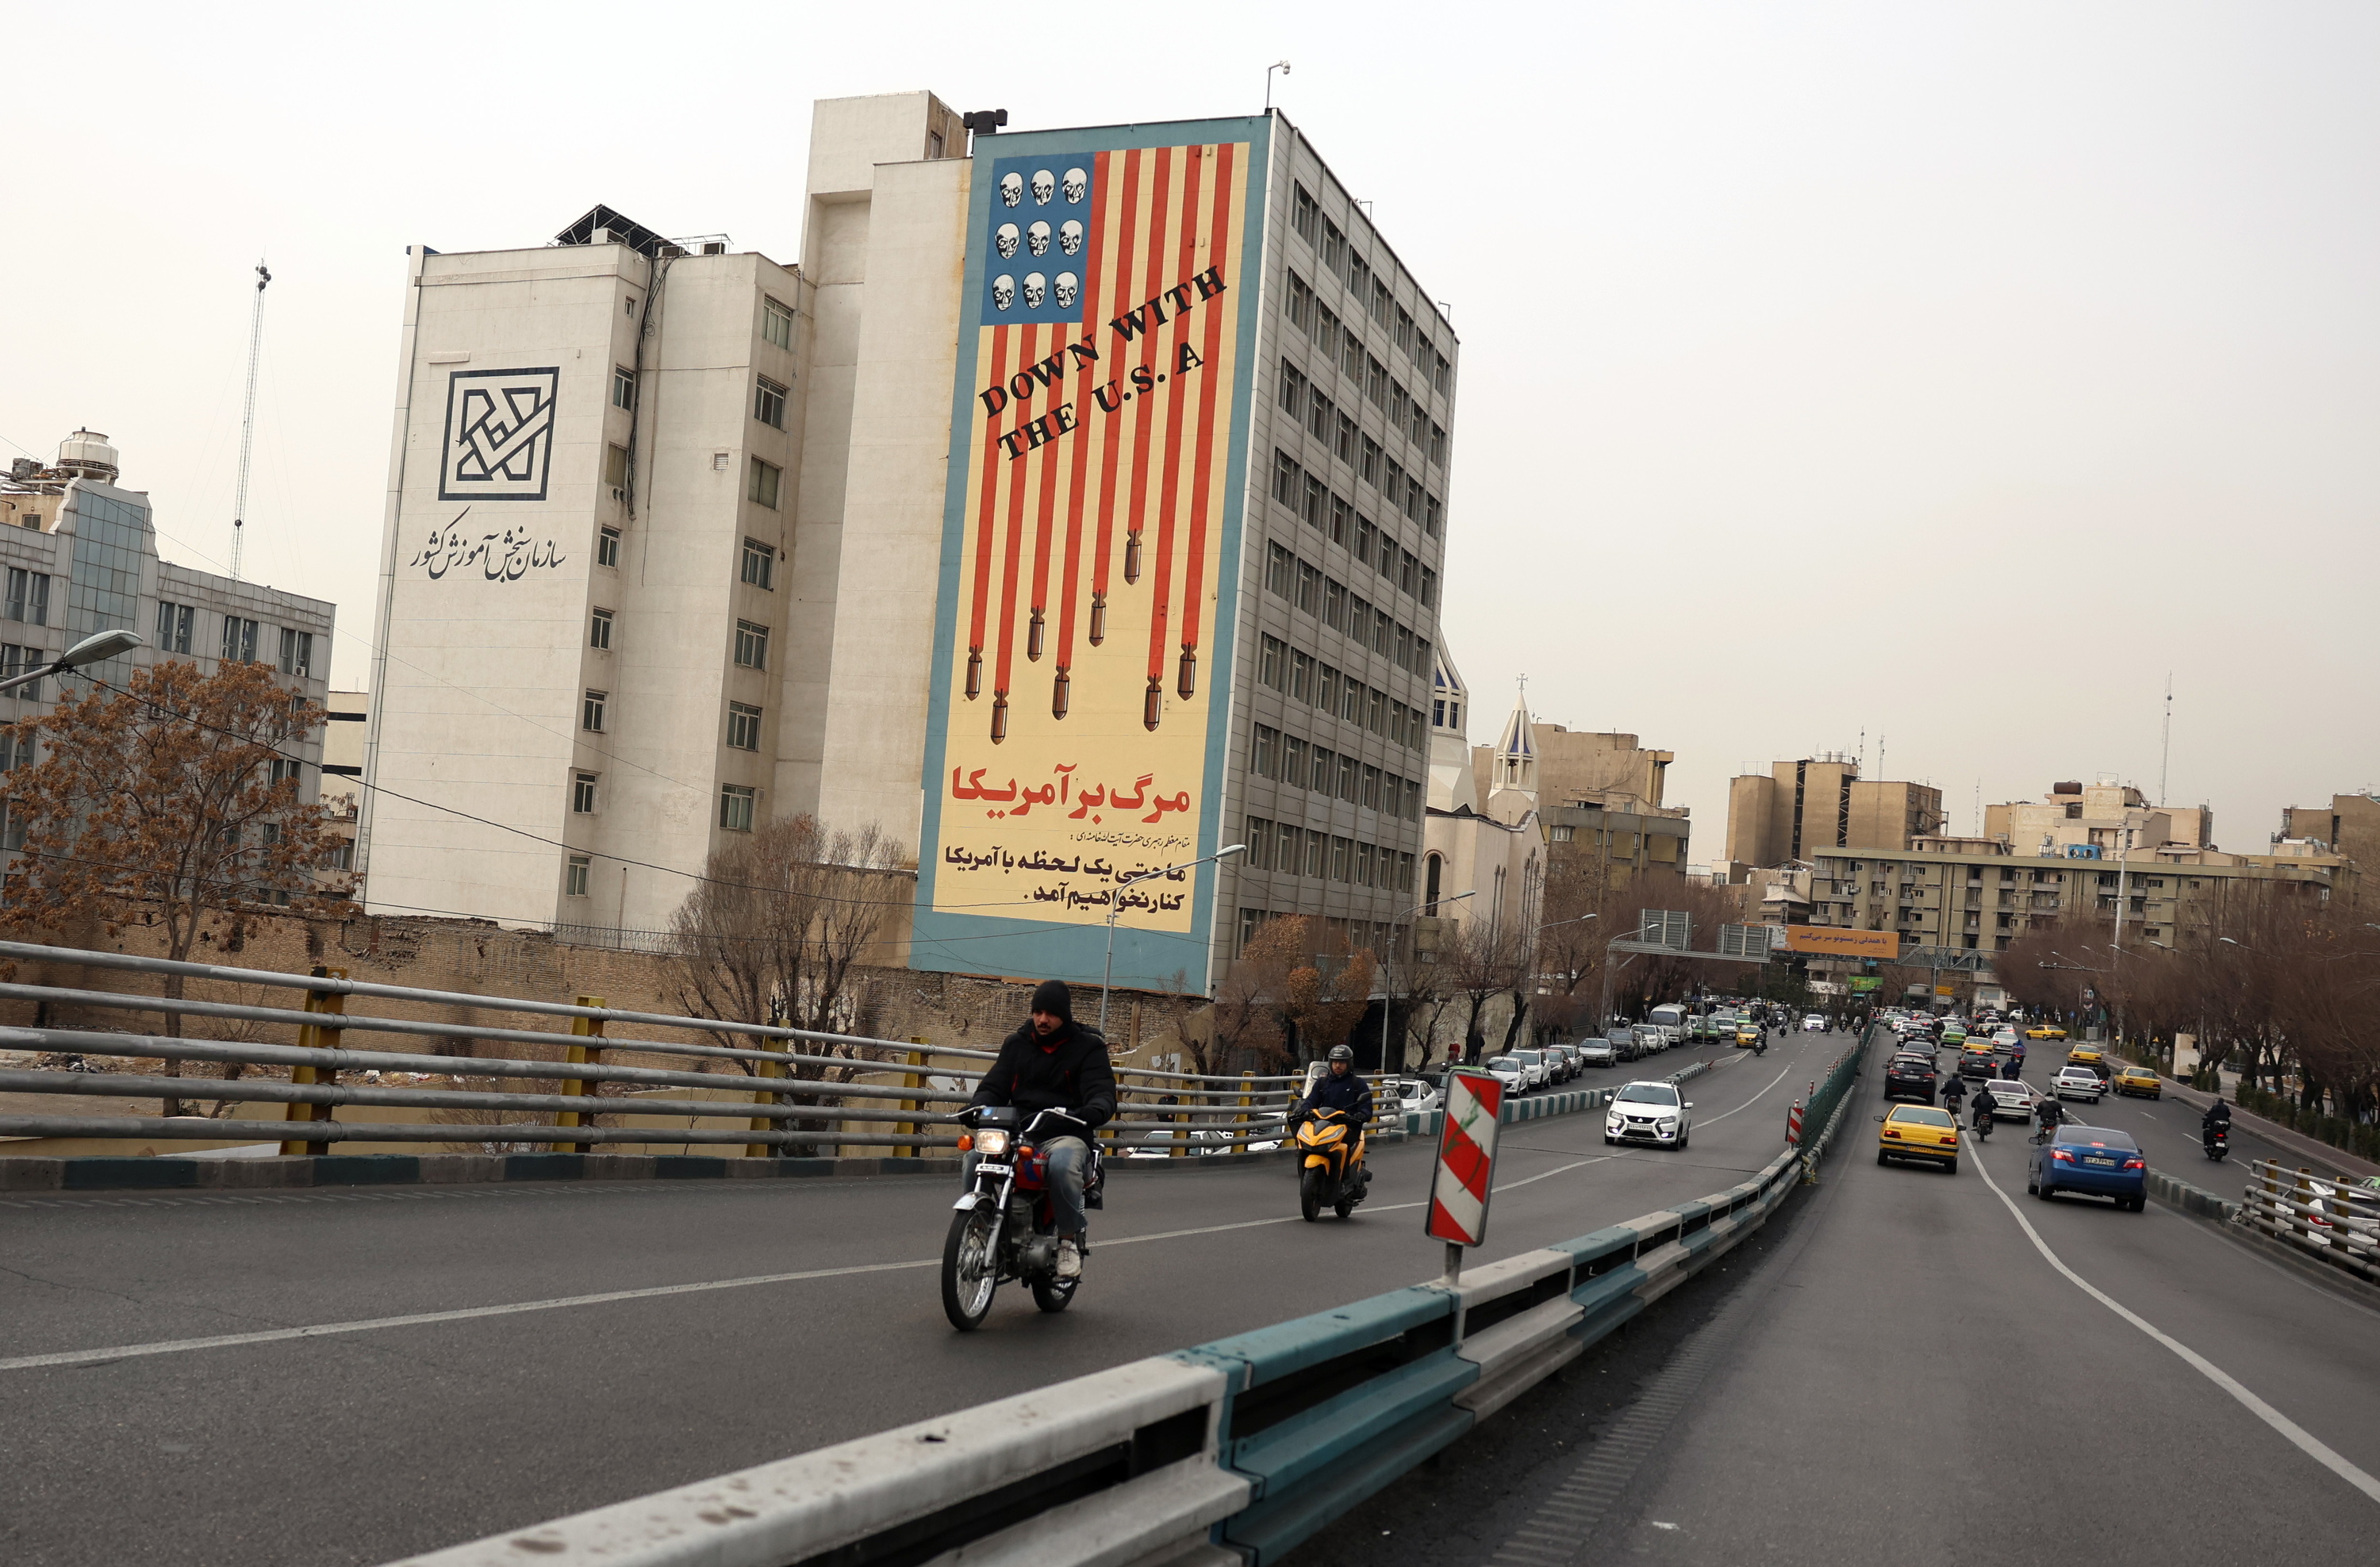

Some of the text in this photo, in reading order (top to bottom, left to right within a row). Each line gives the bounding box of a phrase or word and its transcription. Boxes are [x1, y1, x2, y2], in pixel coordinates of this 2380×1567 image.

[978, 265, 1227, 419] DOWN WITH
[996, 402, 1080, 461] THE
[410, 505, 566, 583] سازمان سنجش آموزش کشور
[952, 763, 1190, 825] مرگ بر آمریکا
[1122, 834, 1143, 847] حضرت
[1142, 837, 1164, 849] رهبری
[1161, 835, 1179, 856] معظم
[1175, 837, 1190, 853] مقام
[945, 846, 1186, 884] ما حتی یک لحظه با آمریکا
[1066, 888, 1150, 912] نخواهیم
[1147, 893, 1185, 913] کنار
[1882, 937, 1887, 946] با
